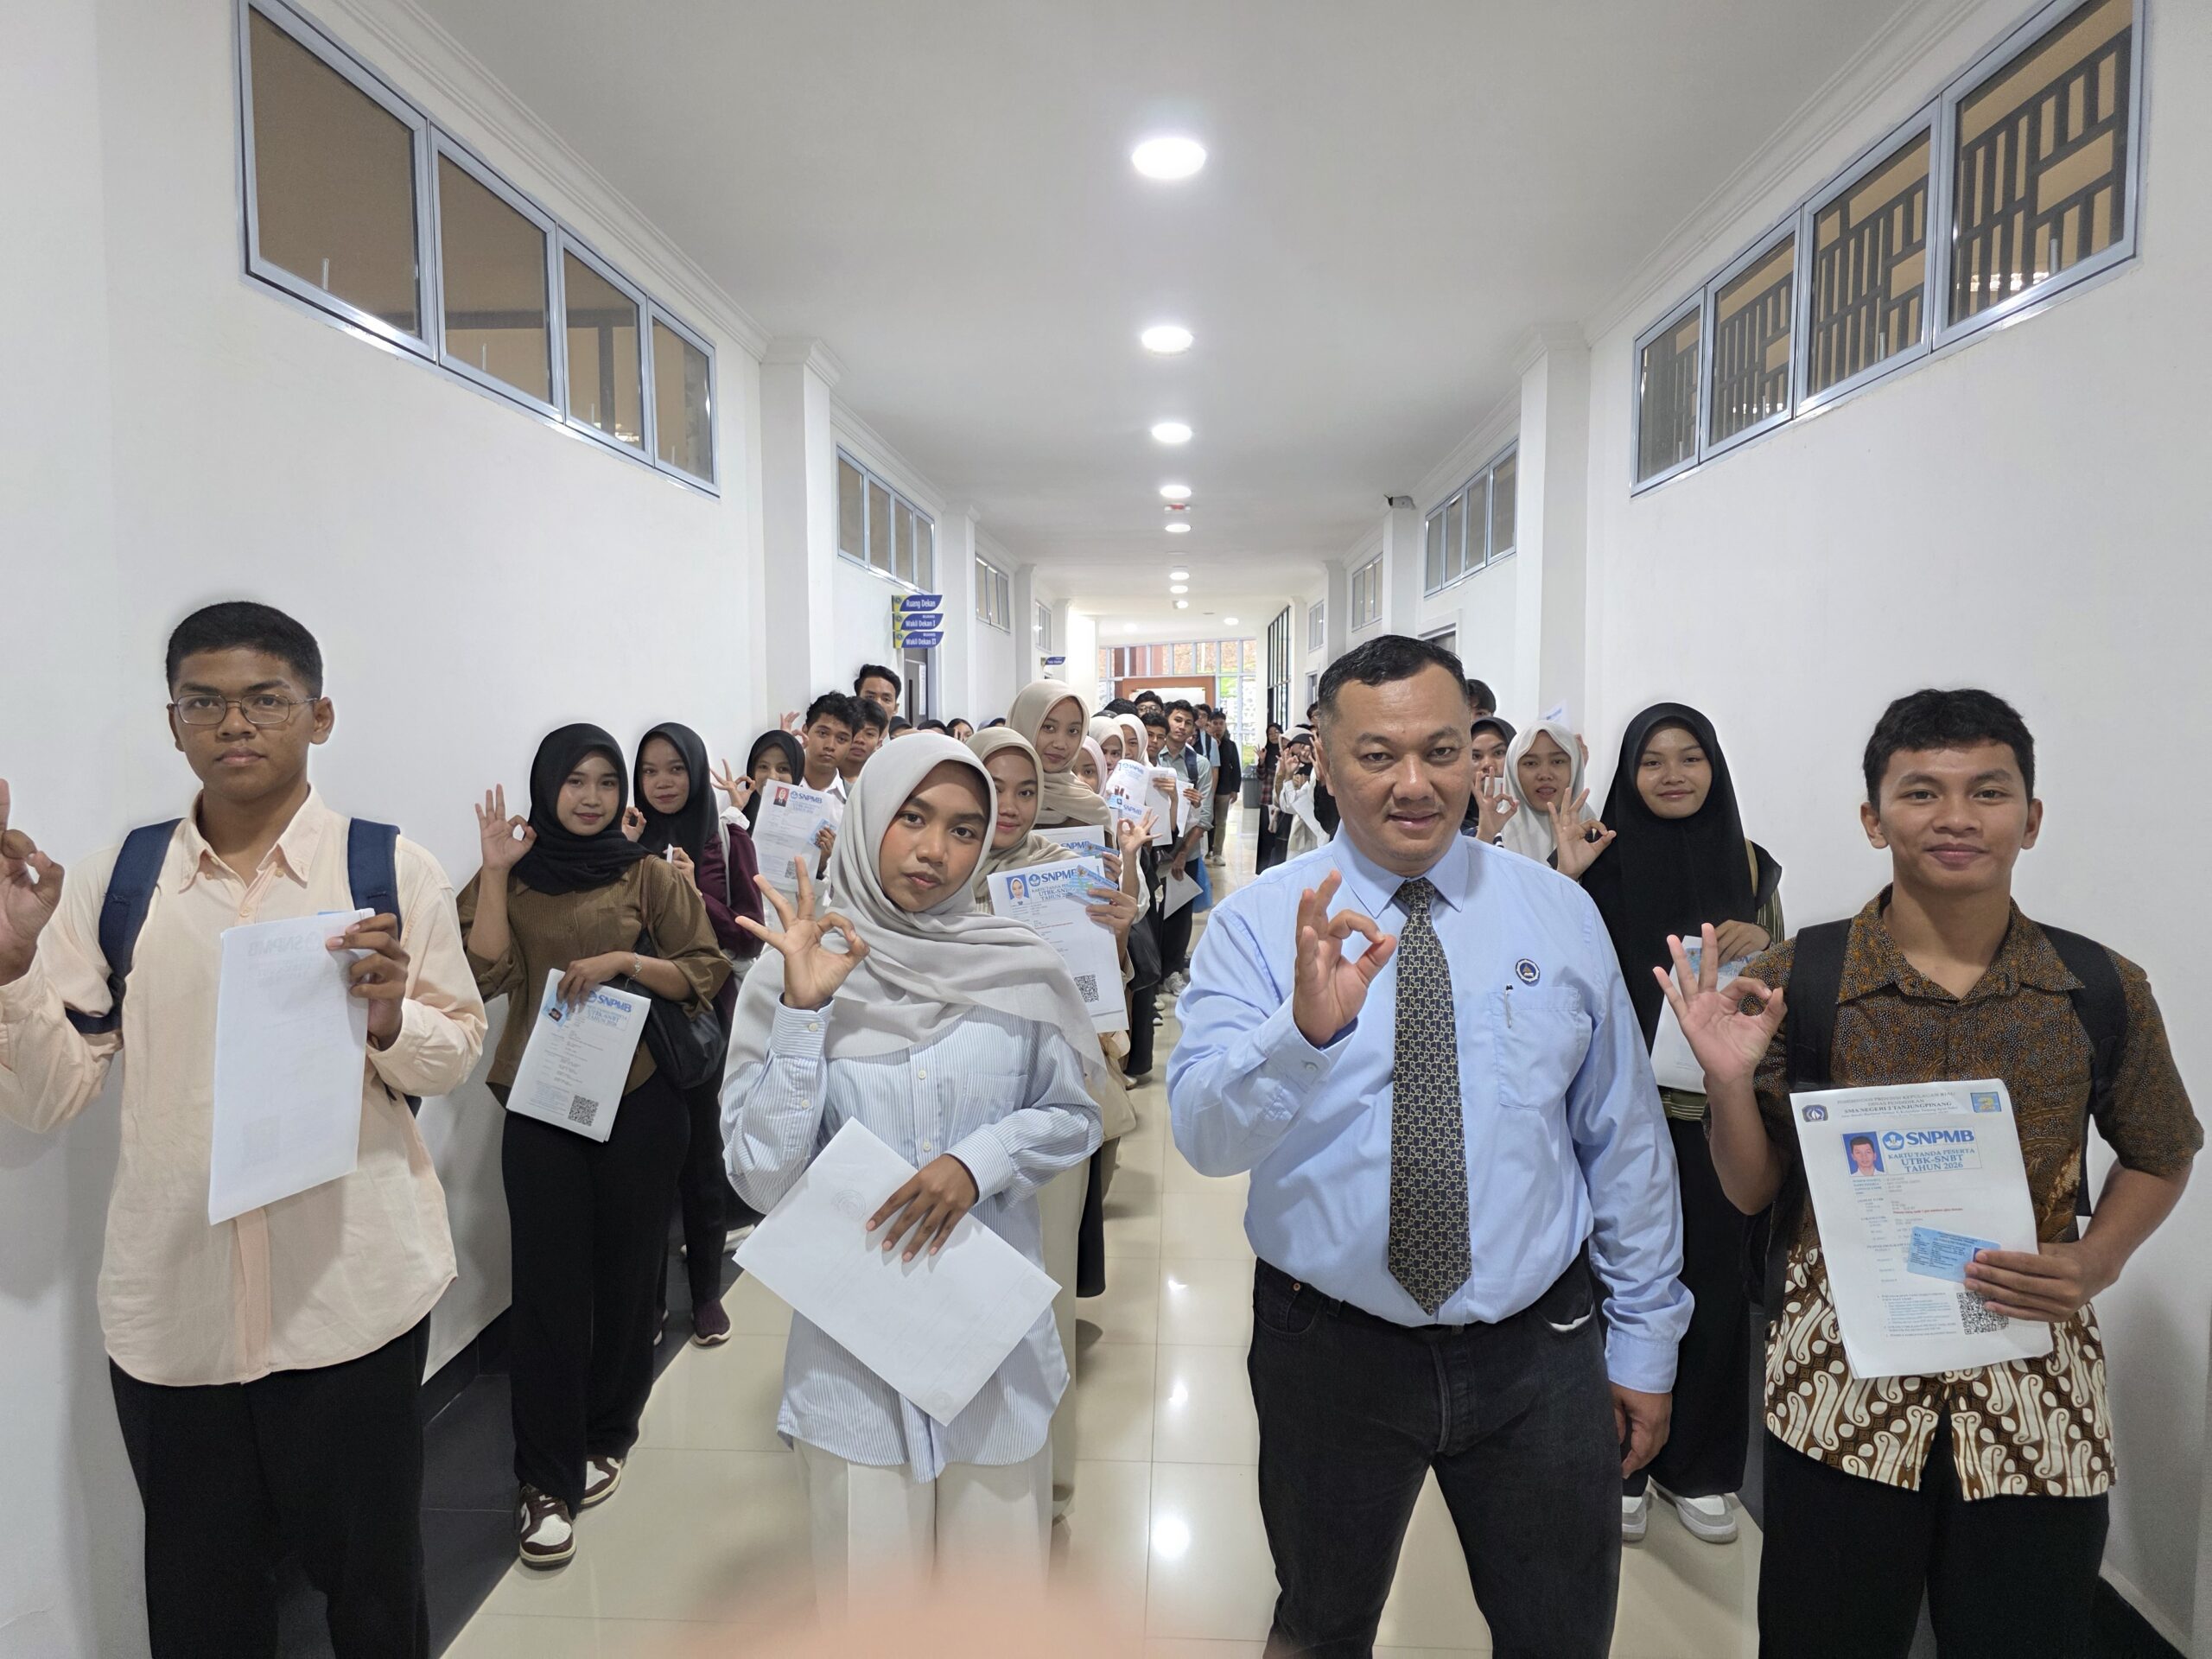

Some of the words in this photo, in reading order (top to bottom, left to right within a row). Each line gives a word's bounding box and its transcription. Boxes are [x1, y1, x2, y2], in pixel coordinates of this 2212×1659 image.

[906, 600, 920, 608] Ruang
[921, 599, 936, 607] Dekan
[1906, 1130, 1975, 1145] SNPMB
[1914, 1149, 1942, 1158] TANDA
[1942, 1147, 1975, 1156] PESERTA
[1901, 1154, 1964, 1166] UTBK-SNBT
[1904, 1163, 1942, 1173] TAHUN
